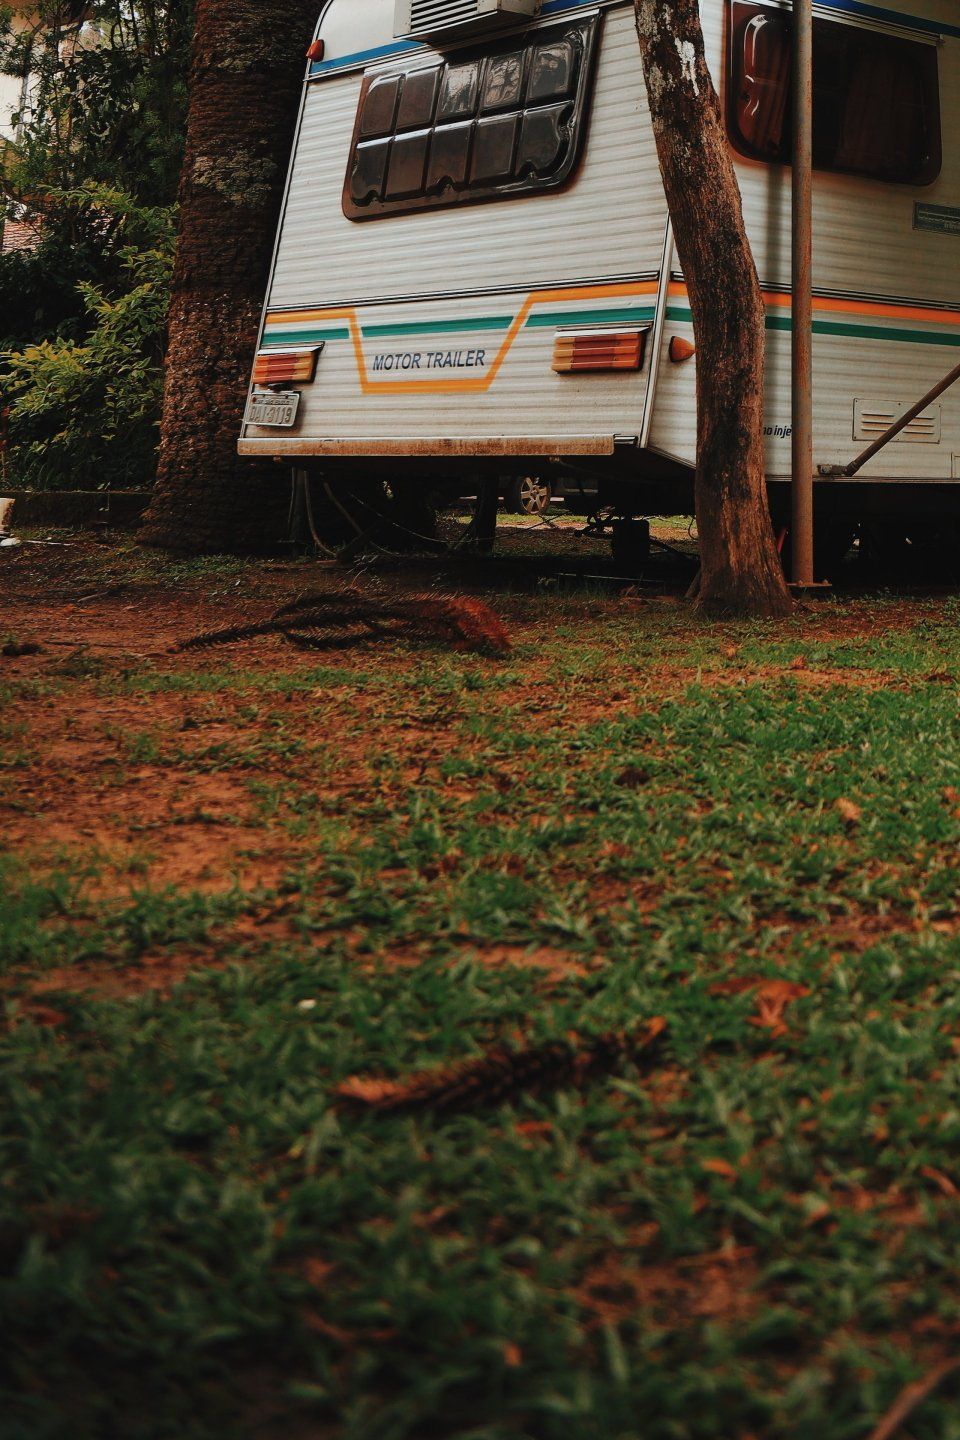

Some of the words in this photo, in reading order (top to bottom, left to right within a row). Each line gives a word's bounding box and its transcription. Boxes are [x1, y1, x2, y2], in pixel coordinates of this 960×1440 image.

[373, 353, 421, 370] MOTOR
[426, 350, 486, 368] TRAILER
[773, 425, 792, 439] inje
